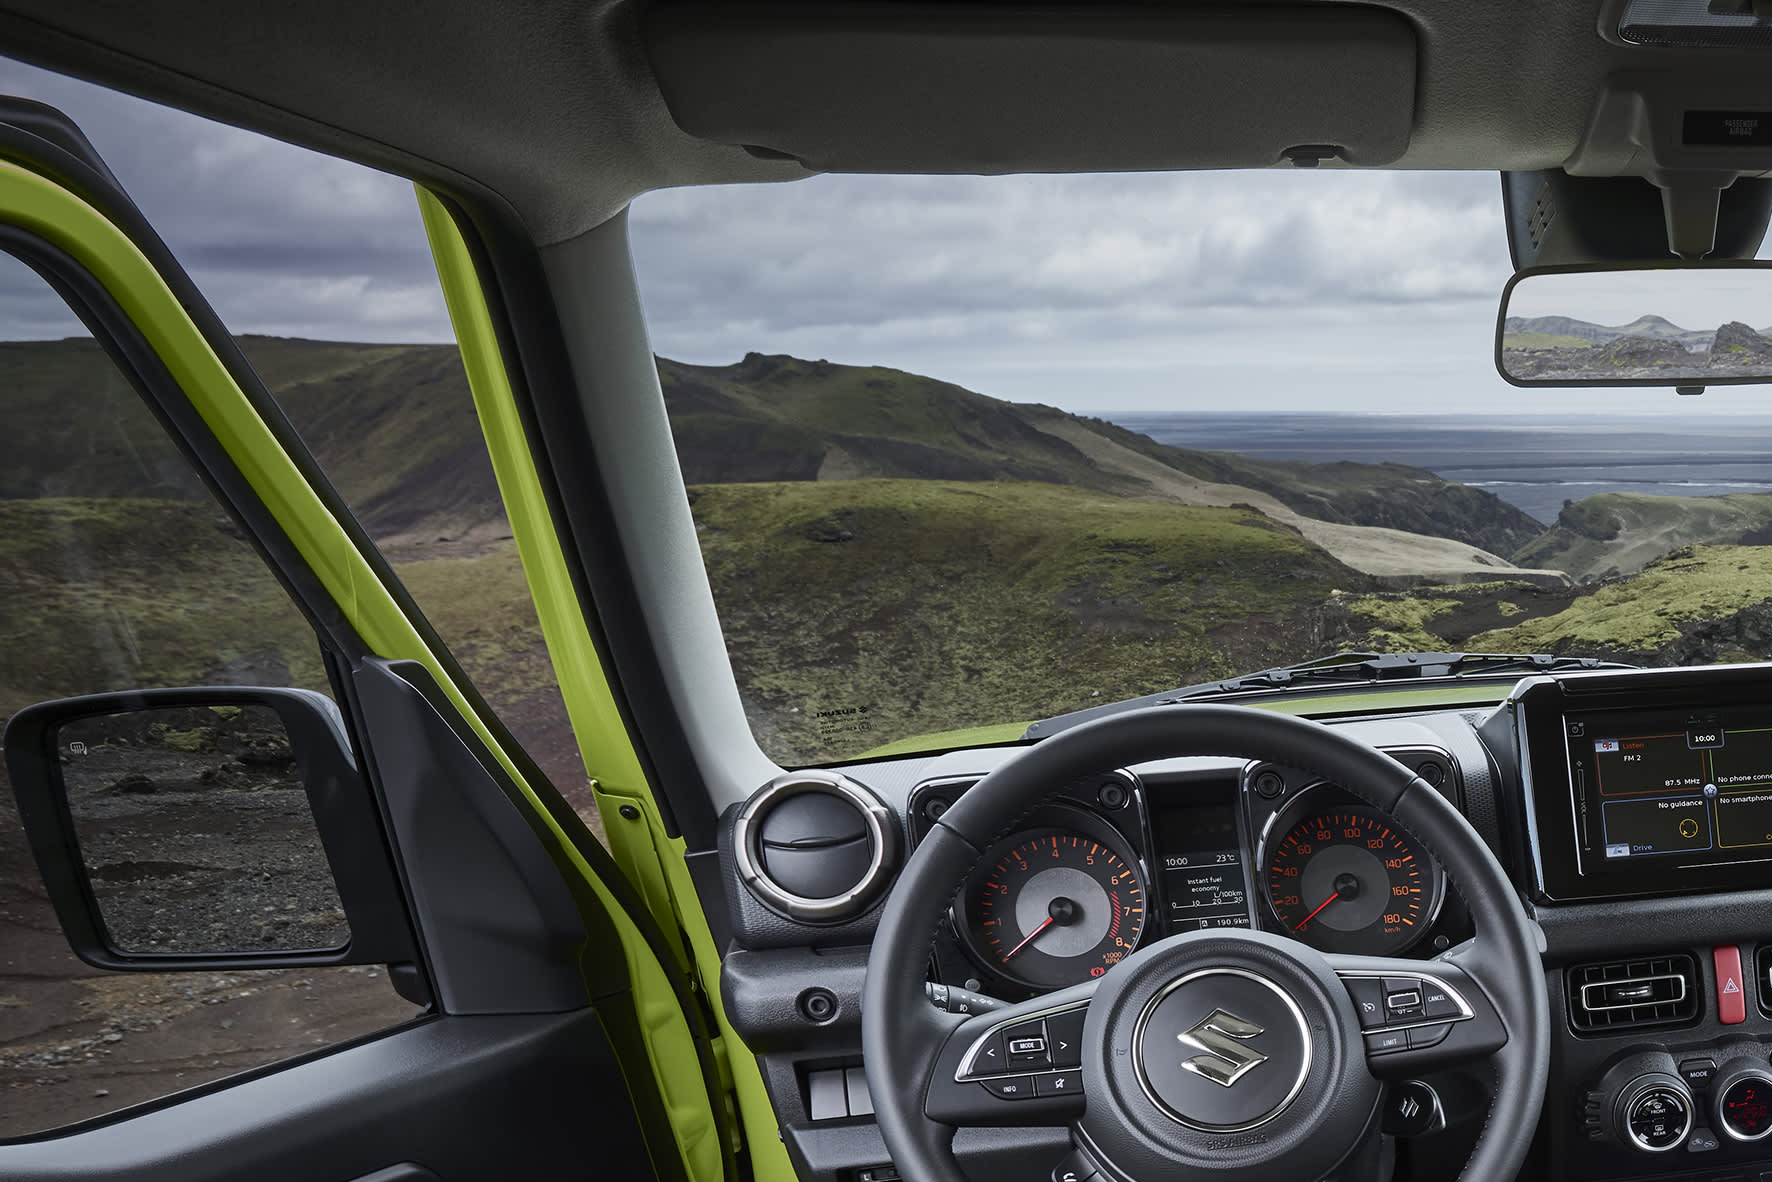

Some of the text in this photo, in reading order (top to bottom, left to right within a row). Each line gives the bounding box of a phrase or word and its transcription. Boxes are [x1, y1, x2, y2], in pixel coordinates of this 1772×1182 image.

[1730, 774, 1752, 783] phone
[1670, 800, 1702, 809] guidance
[1732, 795, 1772, 805] smartphone
[1317, 830, 1331, 840] 80
[1344, 828, 1360, 838] 100
[1368, 839, 1383, 848] 120
[1052, 849, 1059, 858] 4
[1297, 844, 1311, 854] 60
[1087, 856, 1094, 865] 5
[1385, 859, 1401, 869] 140
[1020, 861, 1027, 870] 3
[1284, 867, 1298, 876] 40
[1112, 876, 1118, 885] 6
[1001, 885, 1008, 895] 2
[1392, 886, 1408, 896] 160
[1285, 896, 1298, 905] 20
[1123, 906, 1130, 916] 7
[1384, 914, 1400, 923] 180
[1116, 937, 1123, 946] 8
